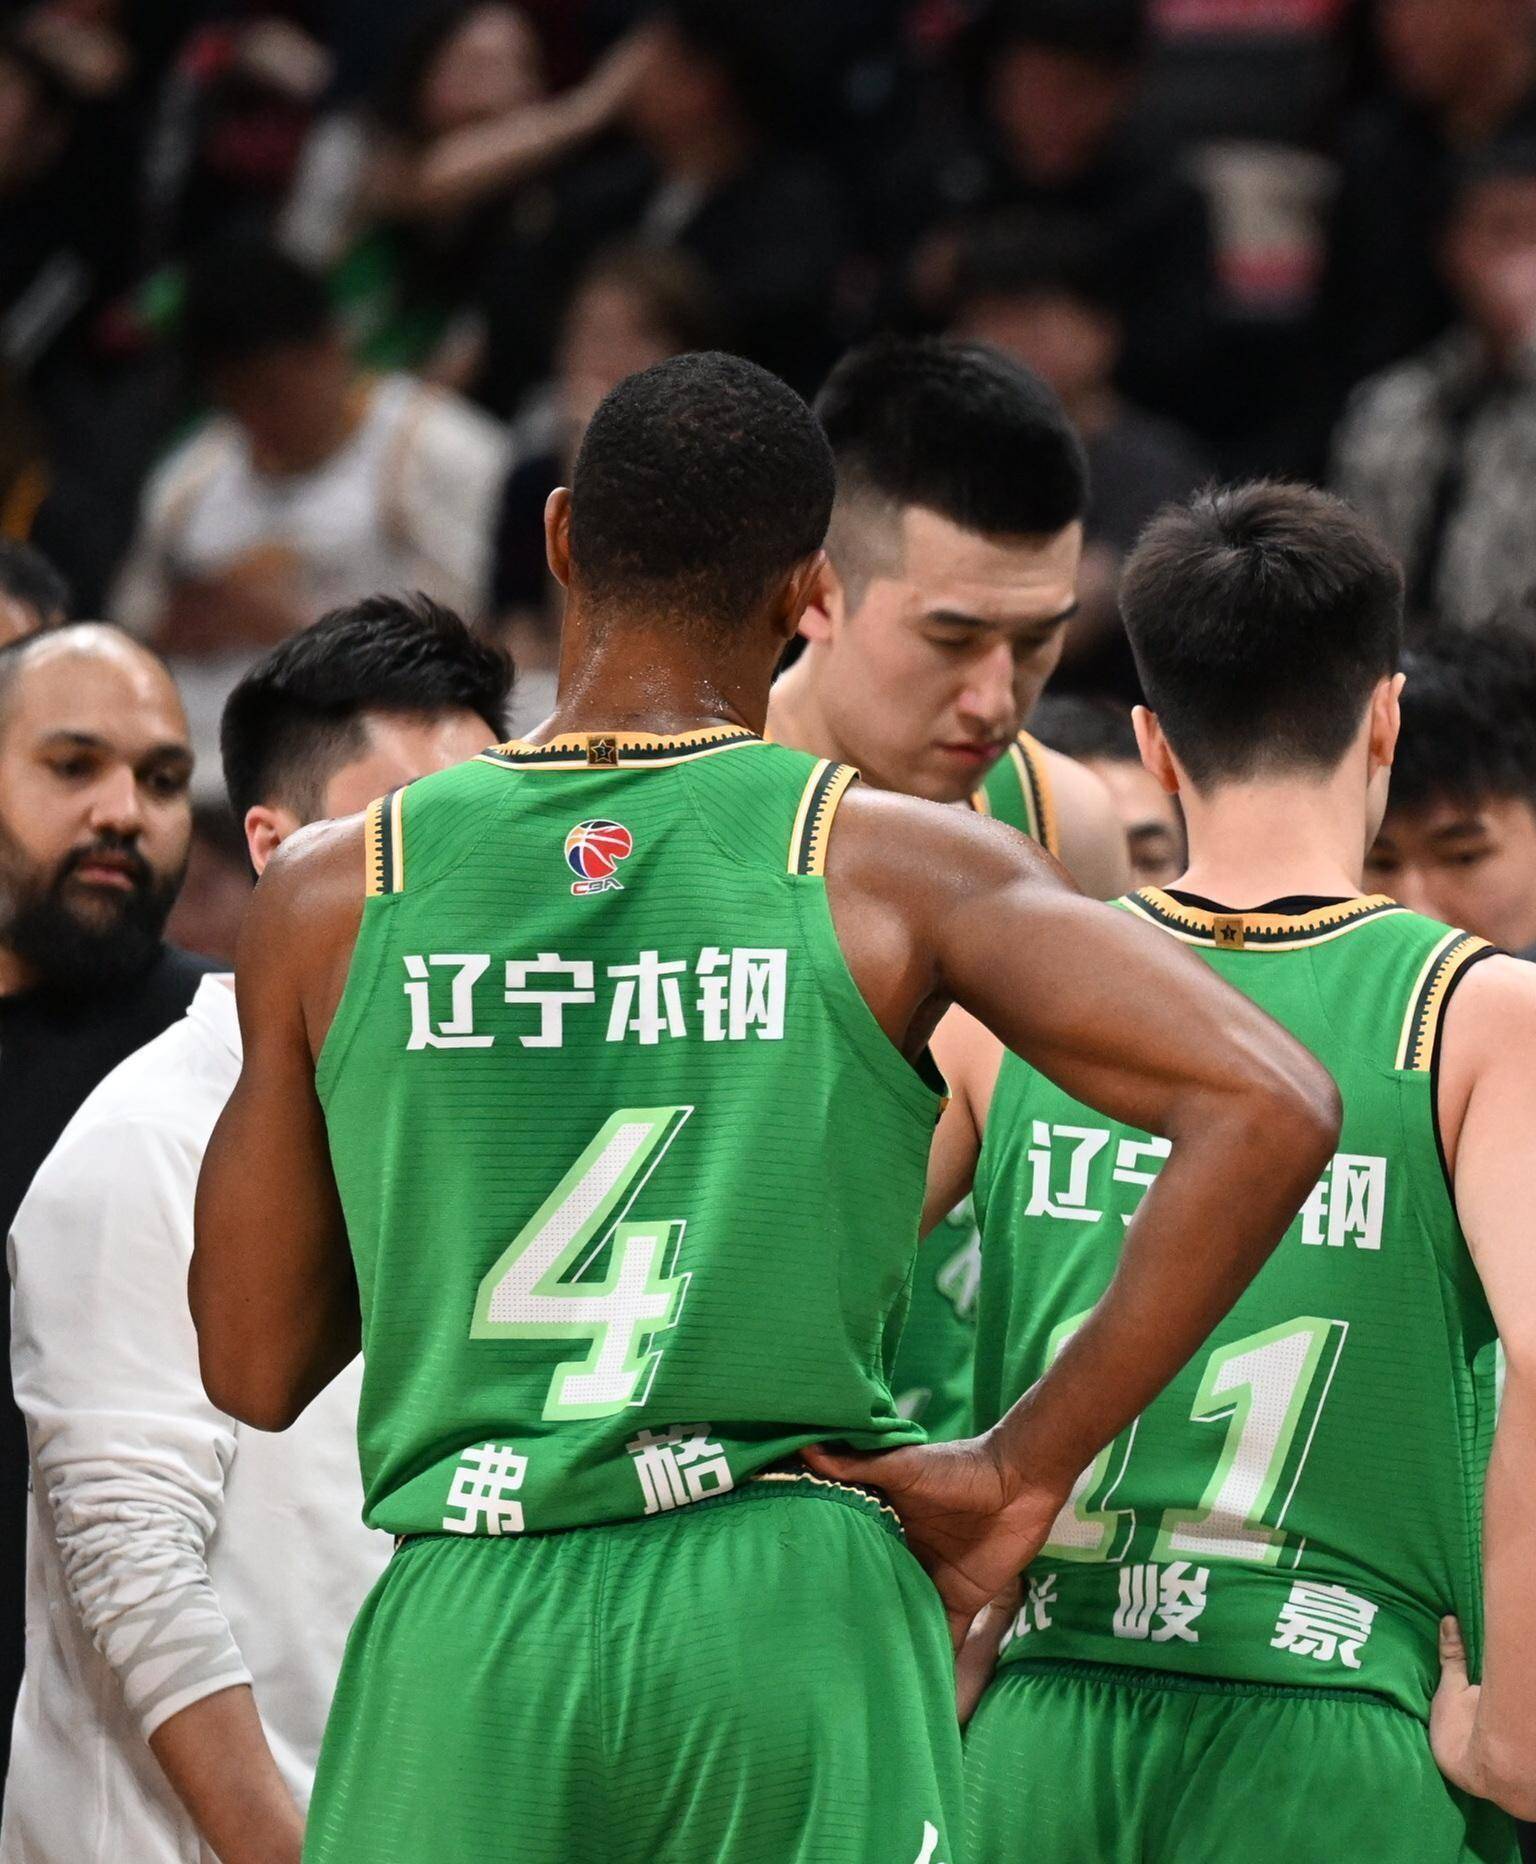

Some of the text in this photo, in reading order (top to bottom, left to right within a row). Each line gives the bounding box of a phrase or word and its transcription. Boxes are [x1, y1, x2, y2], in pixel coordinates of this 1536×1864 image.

[571, 877, 625, 896] CBA
[402, 946, 788, 1050] 辽宁本钢
[1023, 1119, 1388, 1251] 辽宁钢
[470, 1105, 694, 1421] 4
[442, 1422, 735, 1536] 弗格
